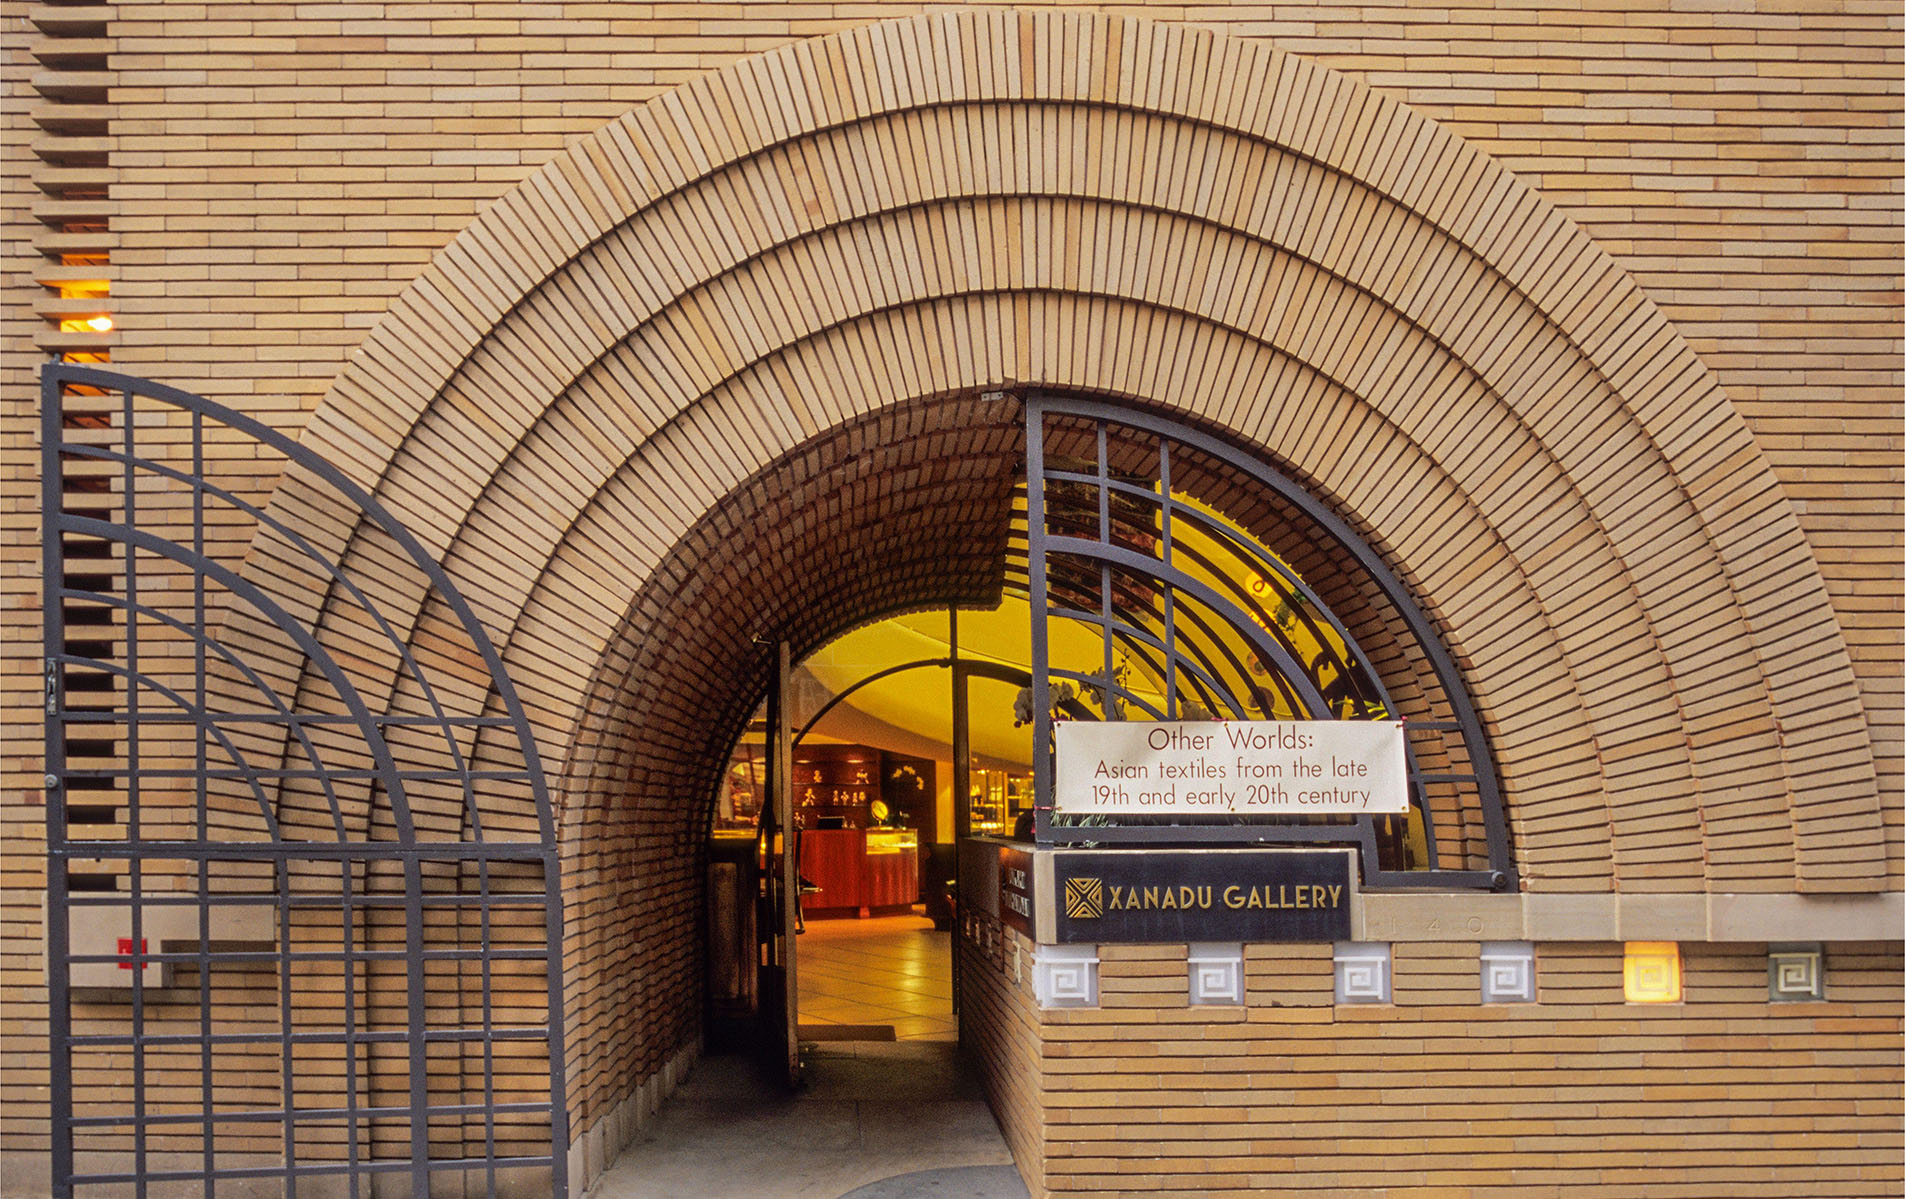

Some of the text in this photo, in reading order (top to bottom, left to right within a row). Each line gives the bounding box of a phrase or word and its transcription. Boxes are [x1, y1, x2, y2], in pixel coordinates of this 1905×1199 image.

[1148, 726, 1313, 751] Other Worlds:
[1095, 756, 1368, 779] Asian textiles from the late
[1092, 783, 1371, 809] 19th and early 20th century
[1109, 884, 1342, 910] XANADU GALLERY
